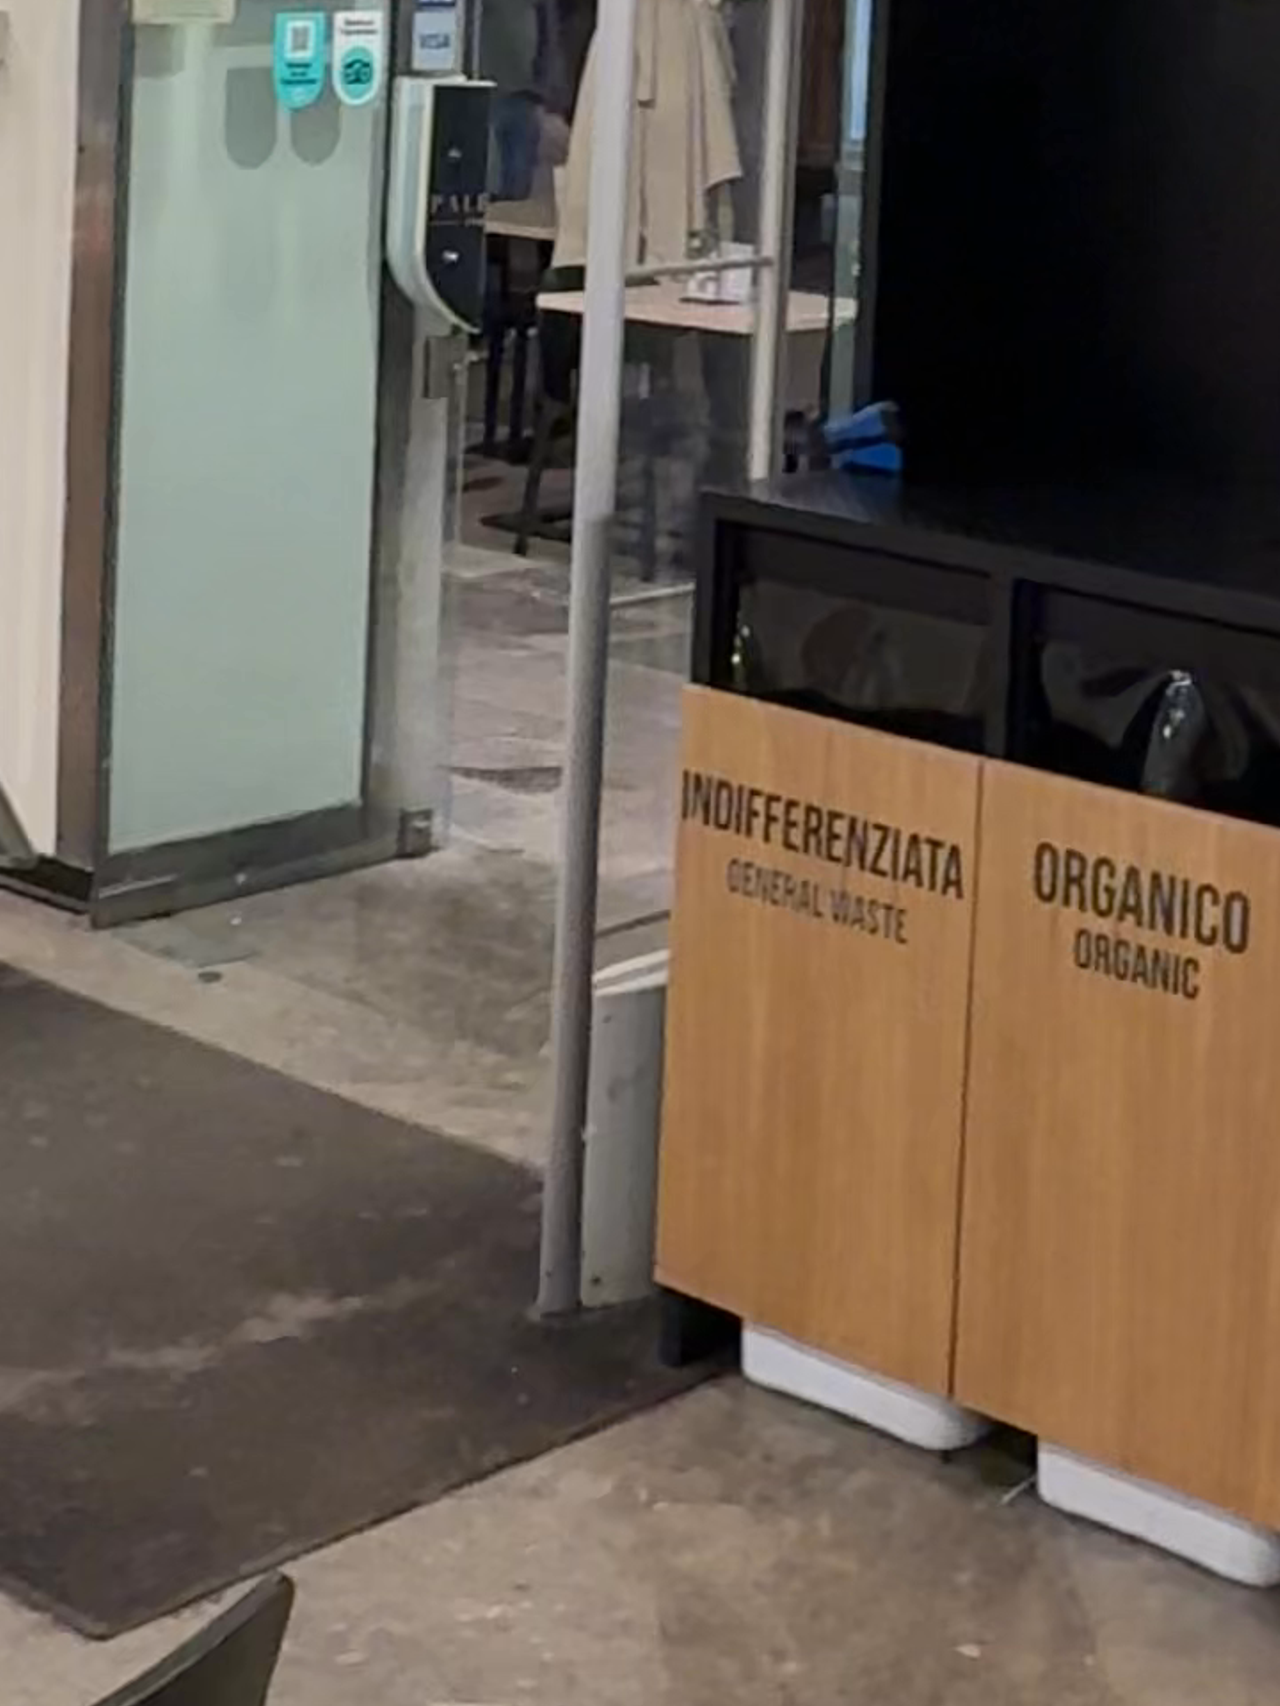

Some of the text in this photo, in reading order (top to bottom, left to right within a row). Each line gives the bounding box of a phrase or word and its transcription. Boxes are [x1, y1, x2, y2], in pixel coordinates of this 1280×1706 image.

[680, 768, 965, 901] INDIFFERENZIATA
[726, 857, 909, 945] GENERAL WASTE
[1033, 841, 1251, 955] ORGANICO
[1073, 928, 1201, 1001] ORGANIC
